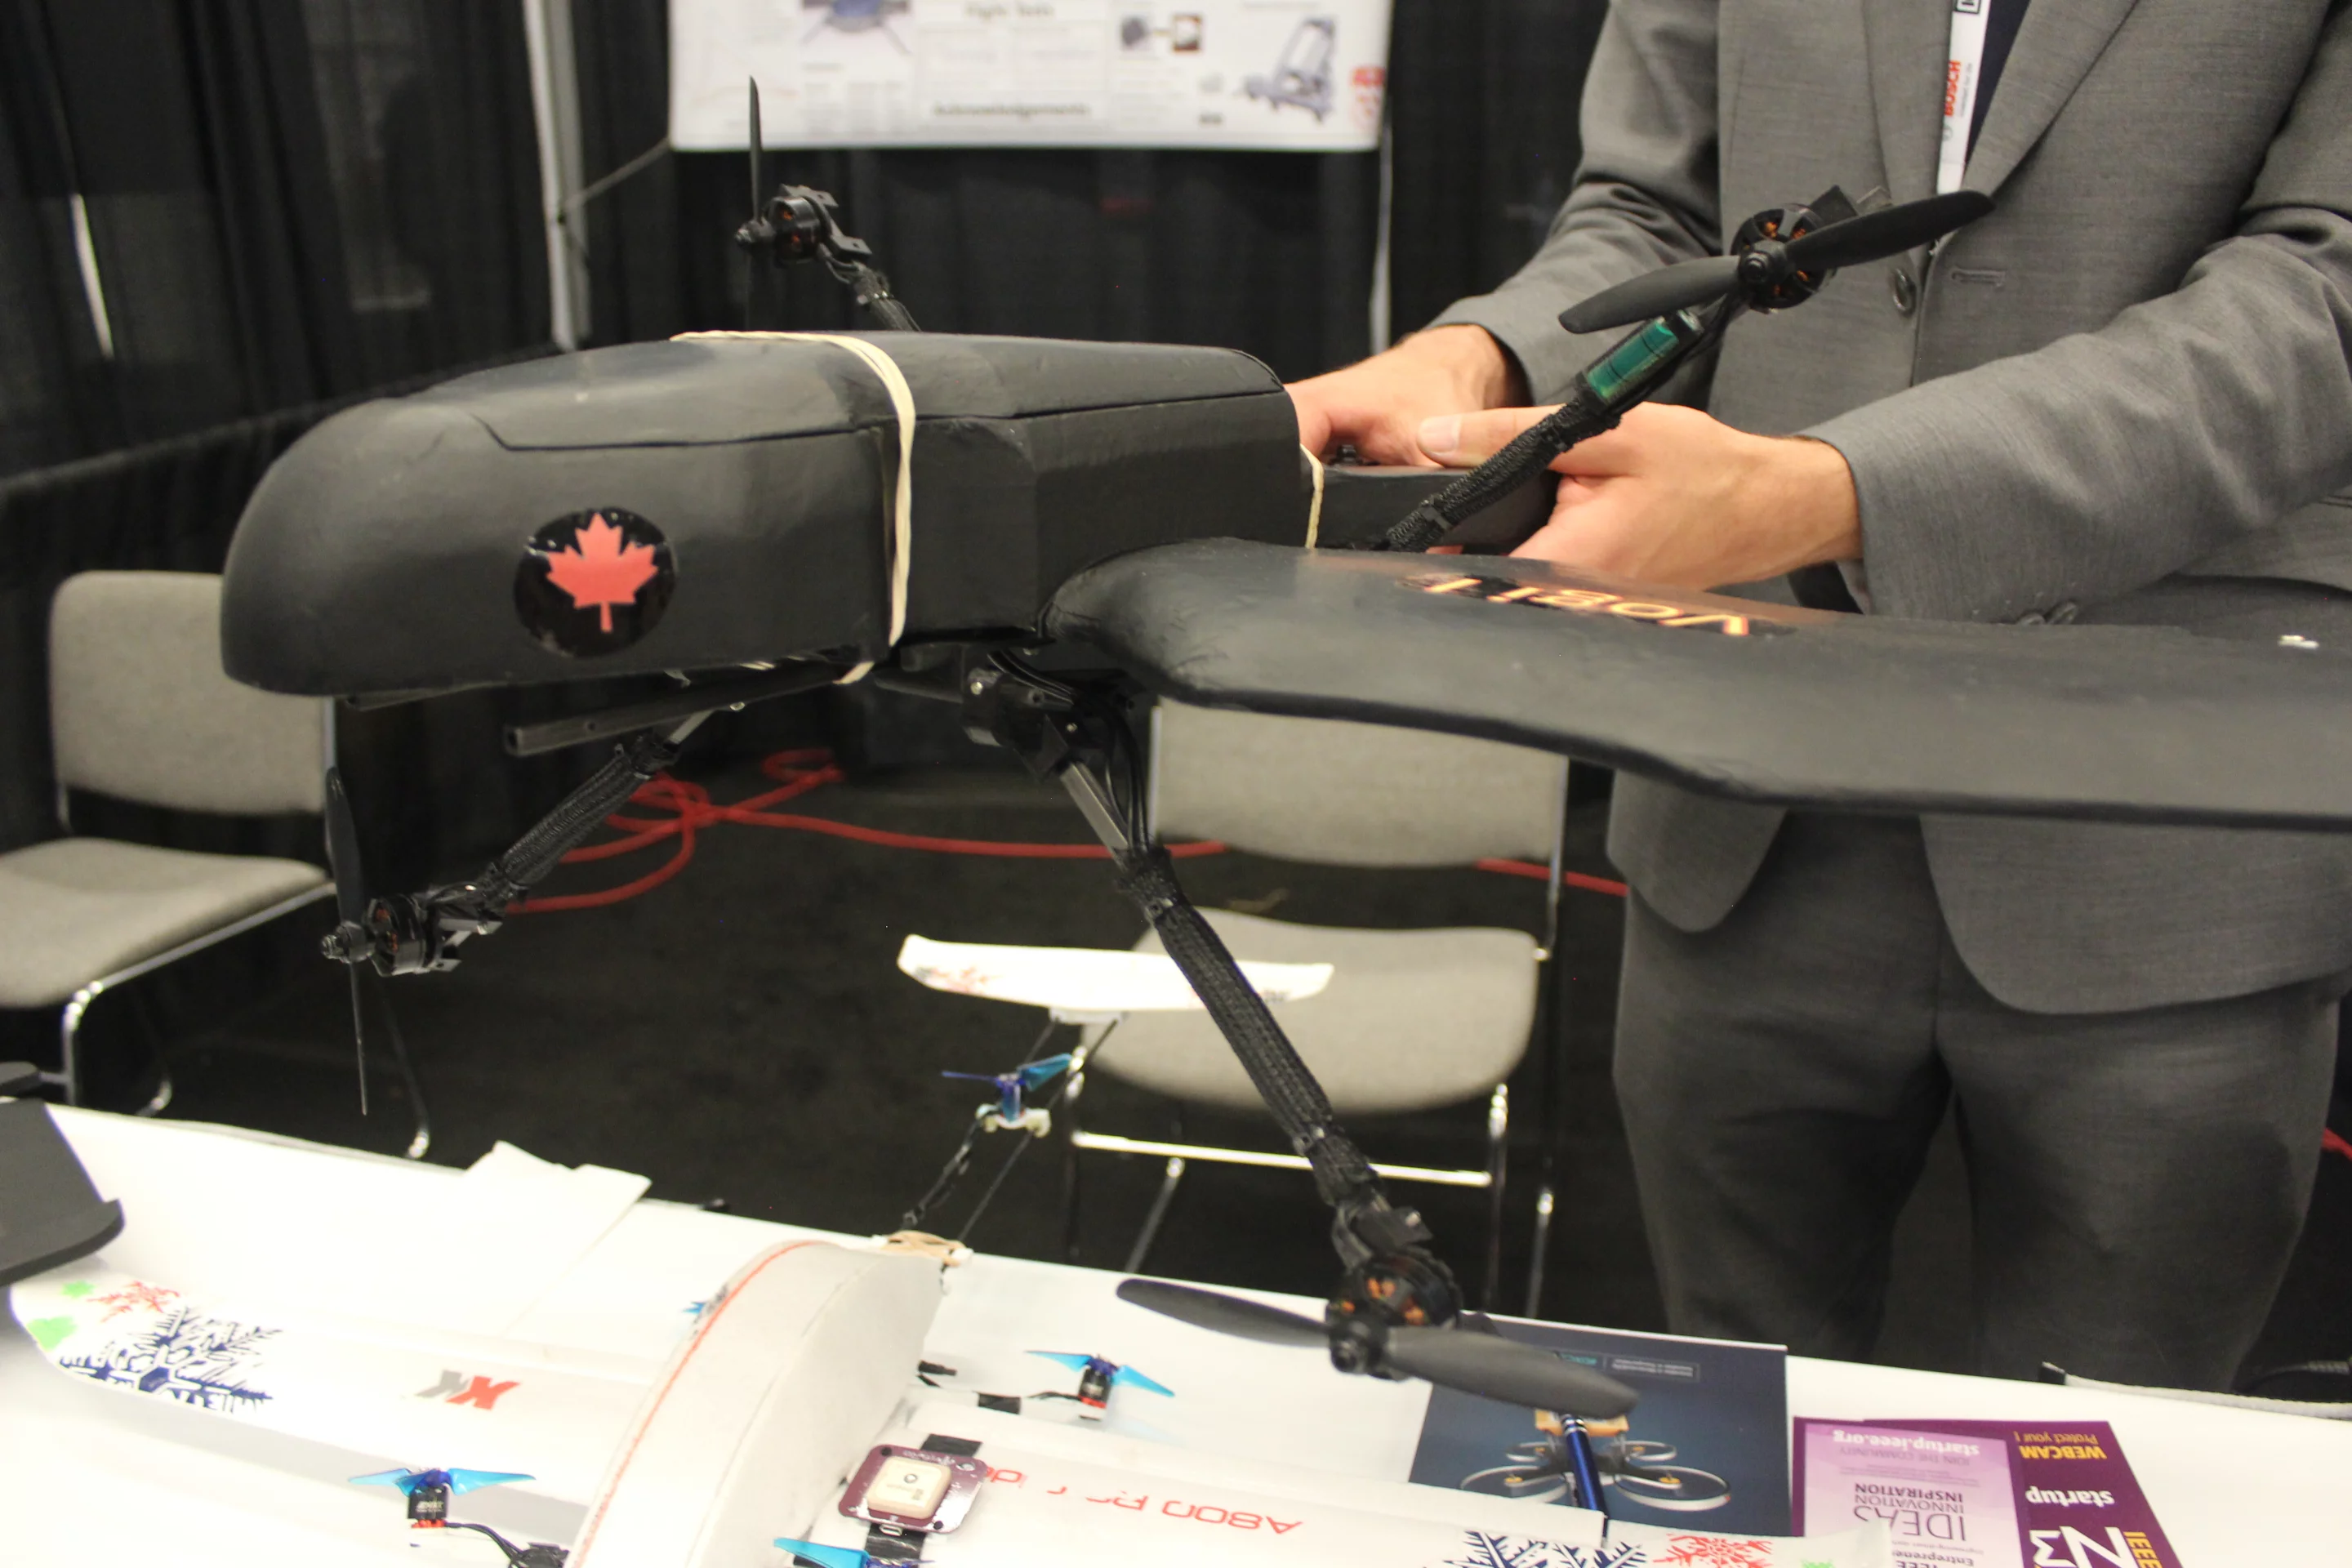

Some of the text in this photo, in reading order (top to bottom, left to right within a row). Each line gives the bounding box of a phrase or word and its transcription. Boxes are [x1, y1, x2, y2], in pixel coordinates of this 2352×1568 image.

[1944, 60, 1961, 116] BOSCH
[1833, 1429, 1980, 1456] startup.ieee.org
[2023, 1432, 2052, 1443] your
[2053, 1432, 2099, 1445] Protect
[2019, 1445, 2108, 1459] WEBCAM
[1854, 1483, 1964, 1503] INSPIRATION
[2025, 1486, 2115, 1508] startup
[1854, 1494, 1965, 1514] INNOVATION
